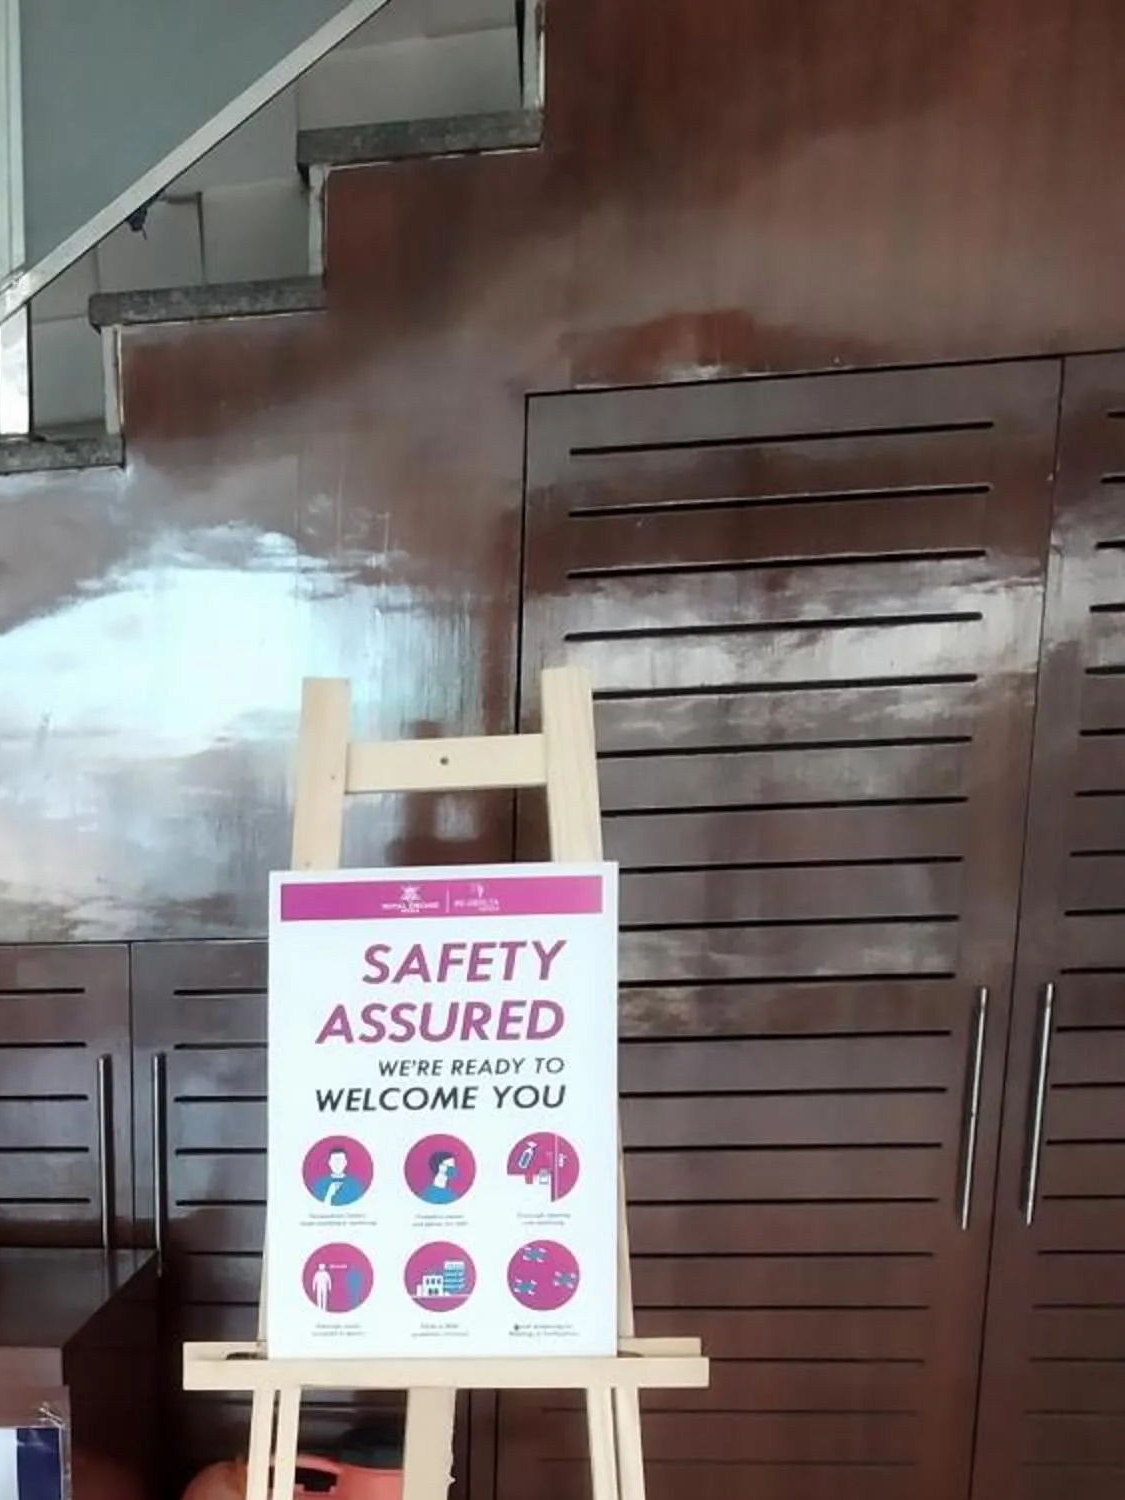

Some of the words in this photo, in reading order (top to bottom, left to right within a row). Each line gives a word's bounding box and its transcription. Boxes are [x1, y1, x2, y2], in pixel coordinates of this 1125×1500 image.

[362, 940, 567, 985] SAFETY
[315, 1000, 565, 1044] ASSURED
[378, 1059, 443, 1077] WE'RE
[450, 1058, 525, 1076] READY
[535, 1056, 565, 1074] TO
[315, 1086, 479, 1112] WELCOME
[492, 1084, 566, 1109] YOU
